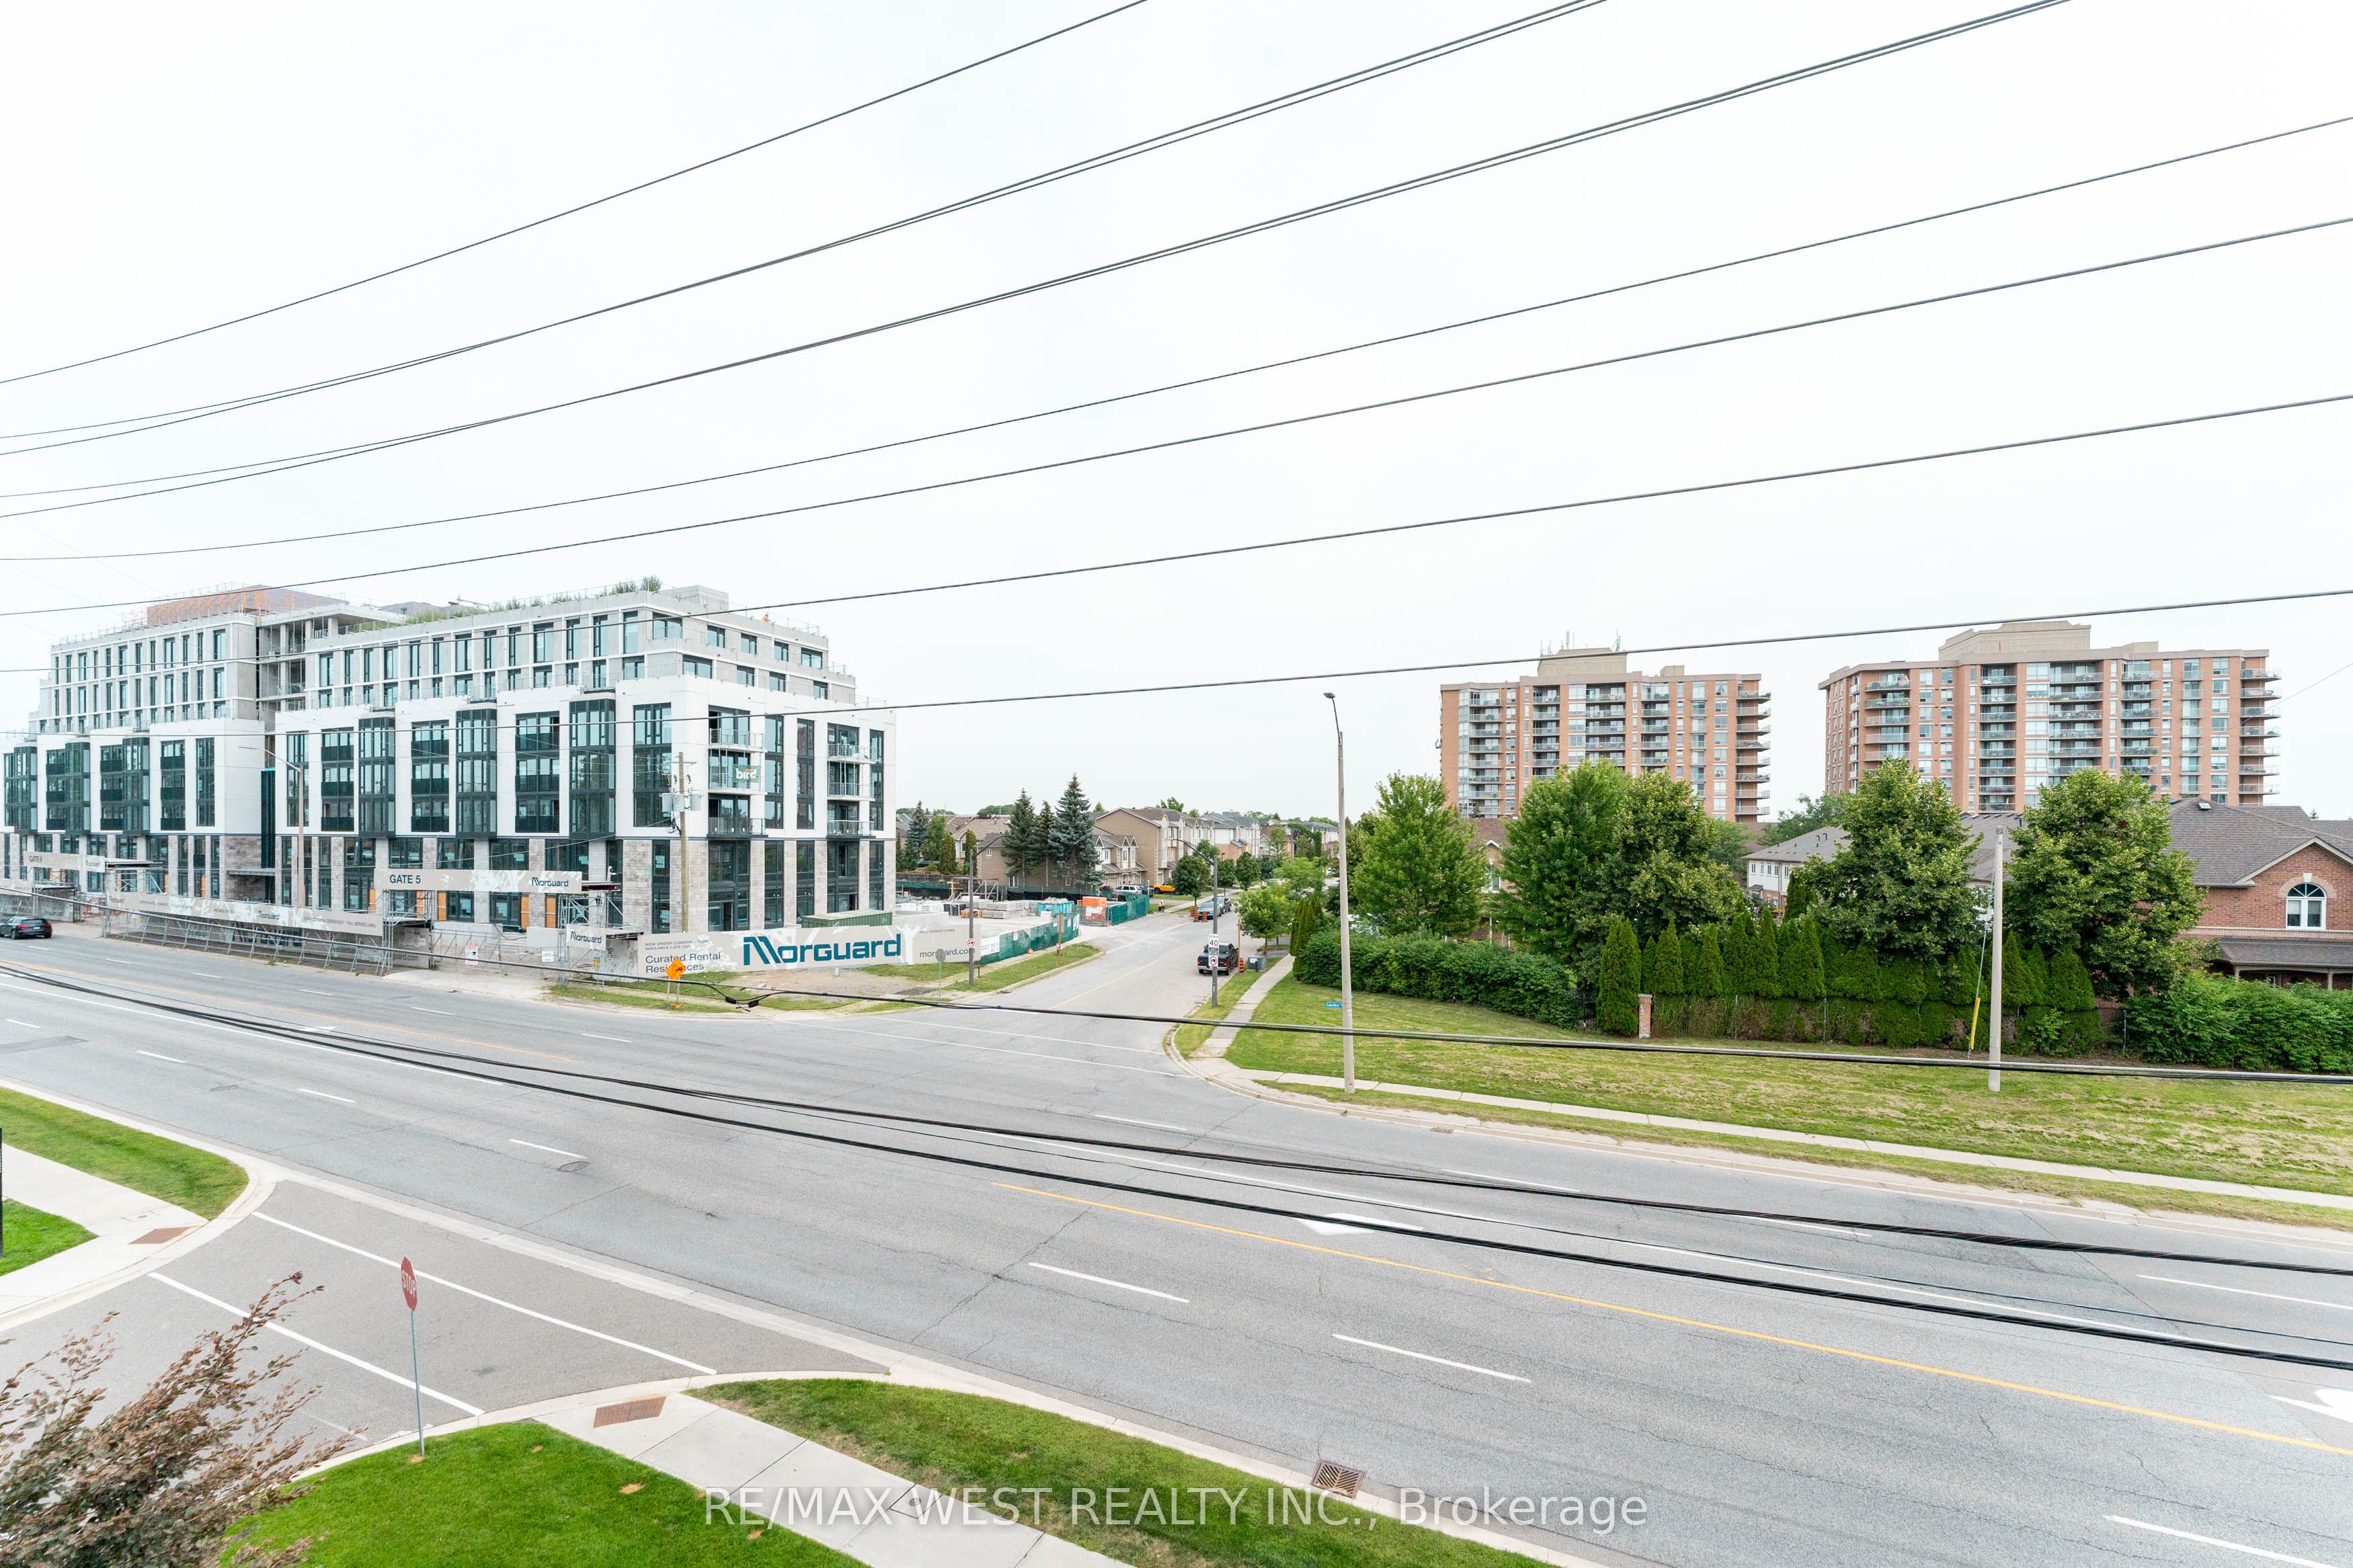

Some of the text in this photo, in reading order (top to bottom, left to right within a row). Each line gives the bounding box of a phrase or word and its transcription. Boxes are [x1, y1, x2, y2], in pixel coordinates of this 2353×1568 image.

[735, 768, 757, 780] bird
[390, 874, 421, 884] GATE 5
[532, 876, 569, 886] Morguard
[570, 931, 602, 944] Morguard
[744, 934, 902, 966] Morguard
[690, 952, 721, 961] Rental
[645, 963, 705, 973] Resices
[402, 1270, 416, 1298] STOP
